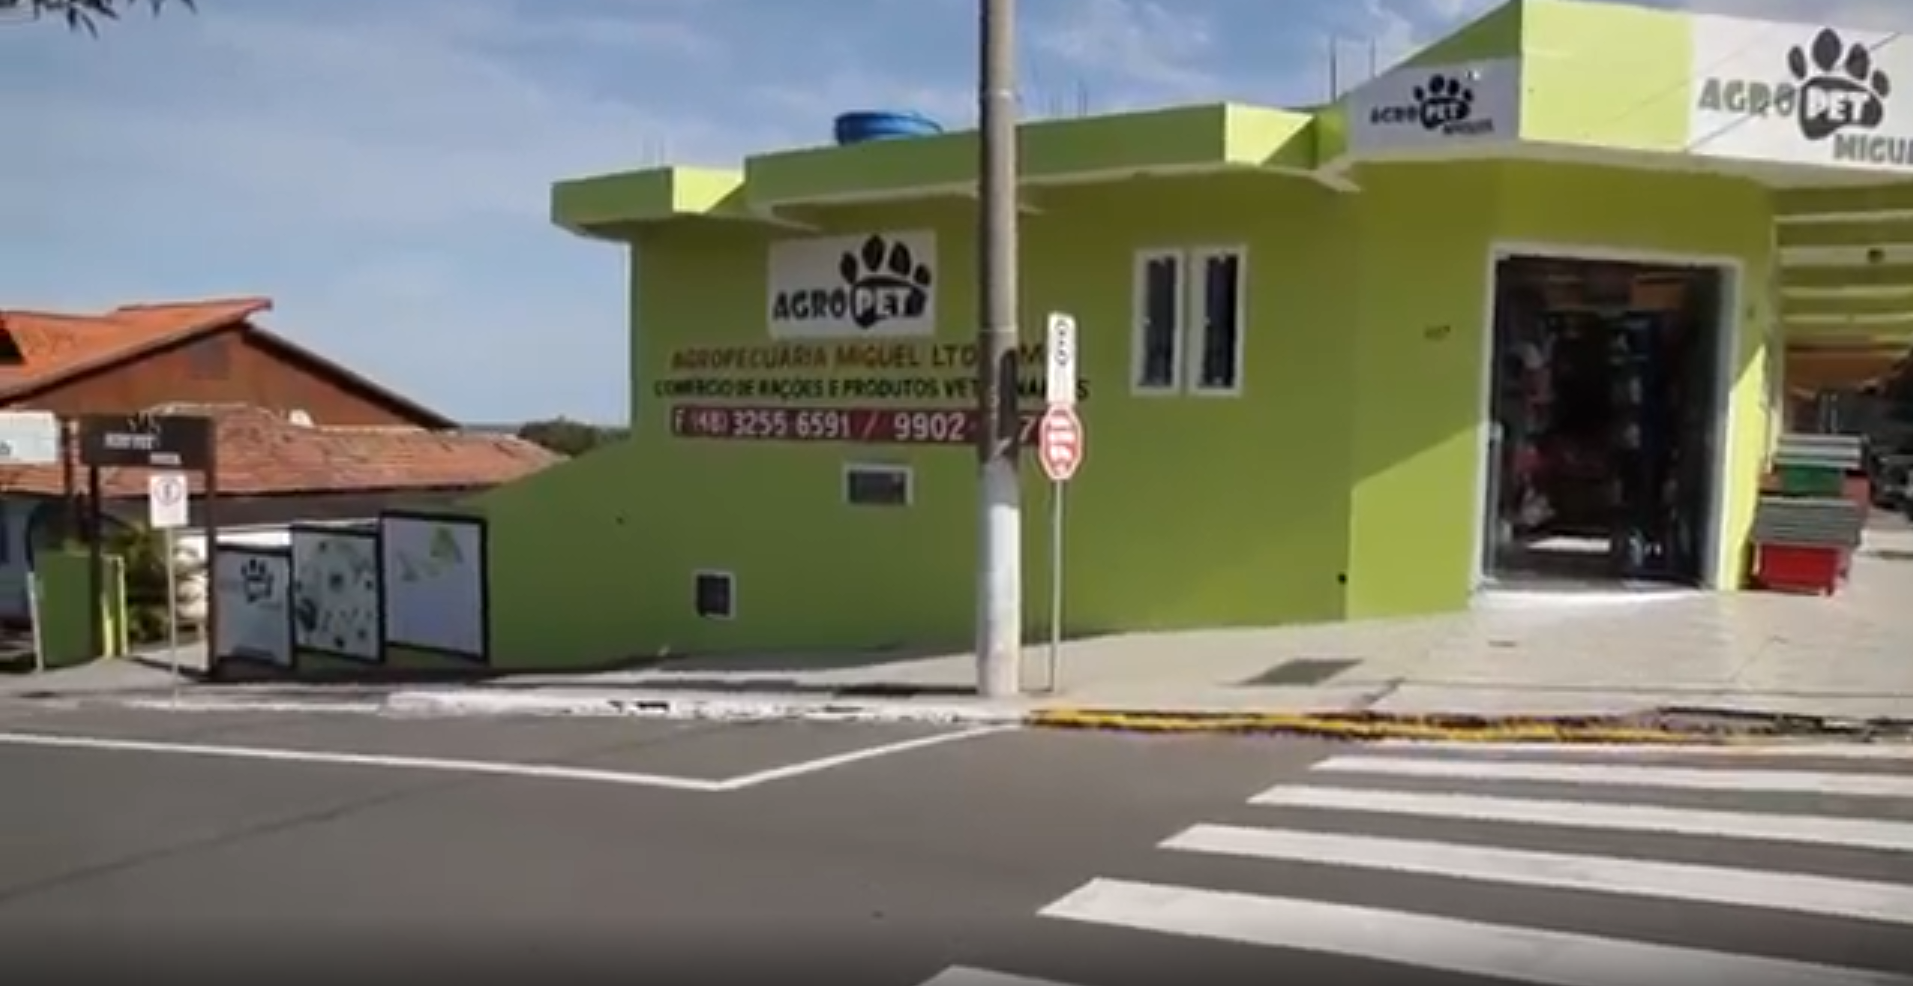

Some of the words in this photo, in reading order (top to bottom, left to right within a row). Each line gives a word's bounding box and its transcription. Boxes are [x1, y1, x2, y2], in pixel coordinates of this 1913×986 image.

[836, 343, 920, 369] MIGUEL
[932, 343, 978, 369] LTD
[736, 379, 755, 397] DE
[829, 379, 839, 398] E
[844, 377, 939, 398] PRODUTOS
[733, 409, 788, 437] 3255
[796, 411, 850, 438] 6591
